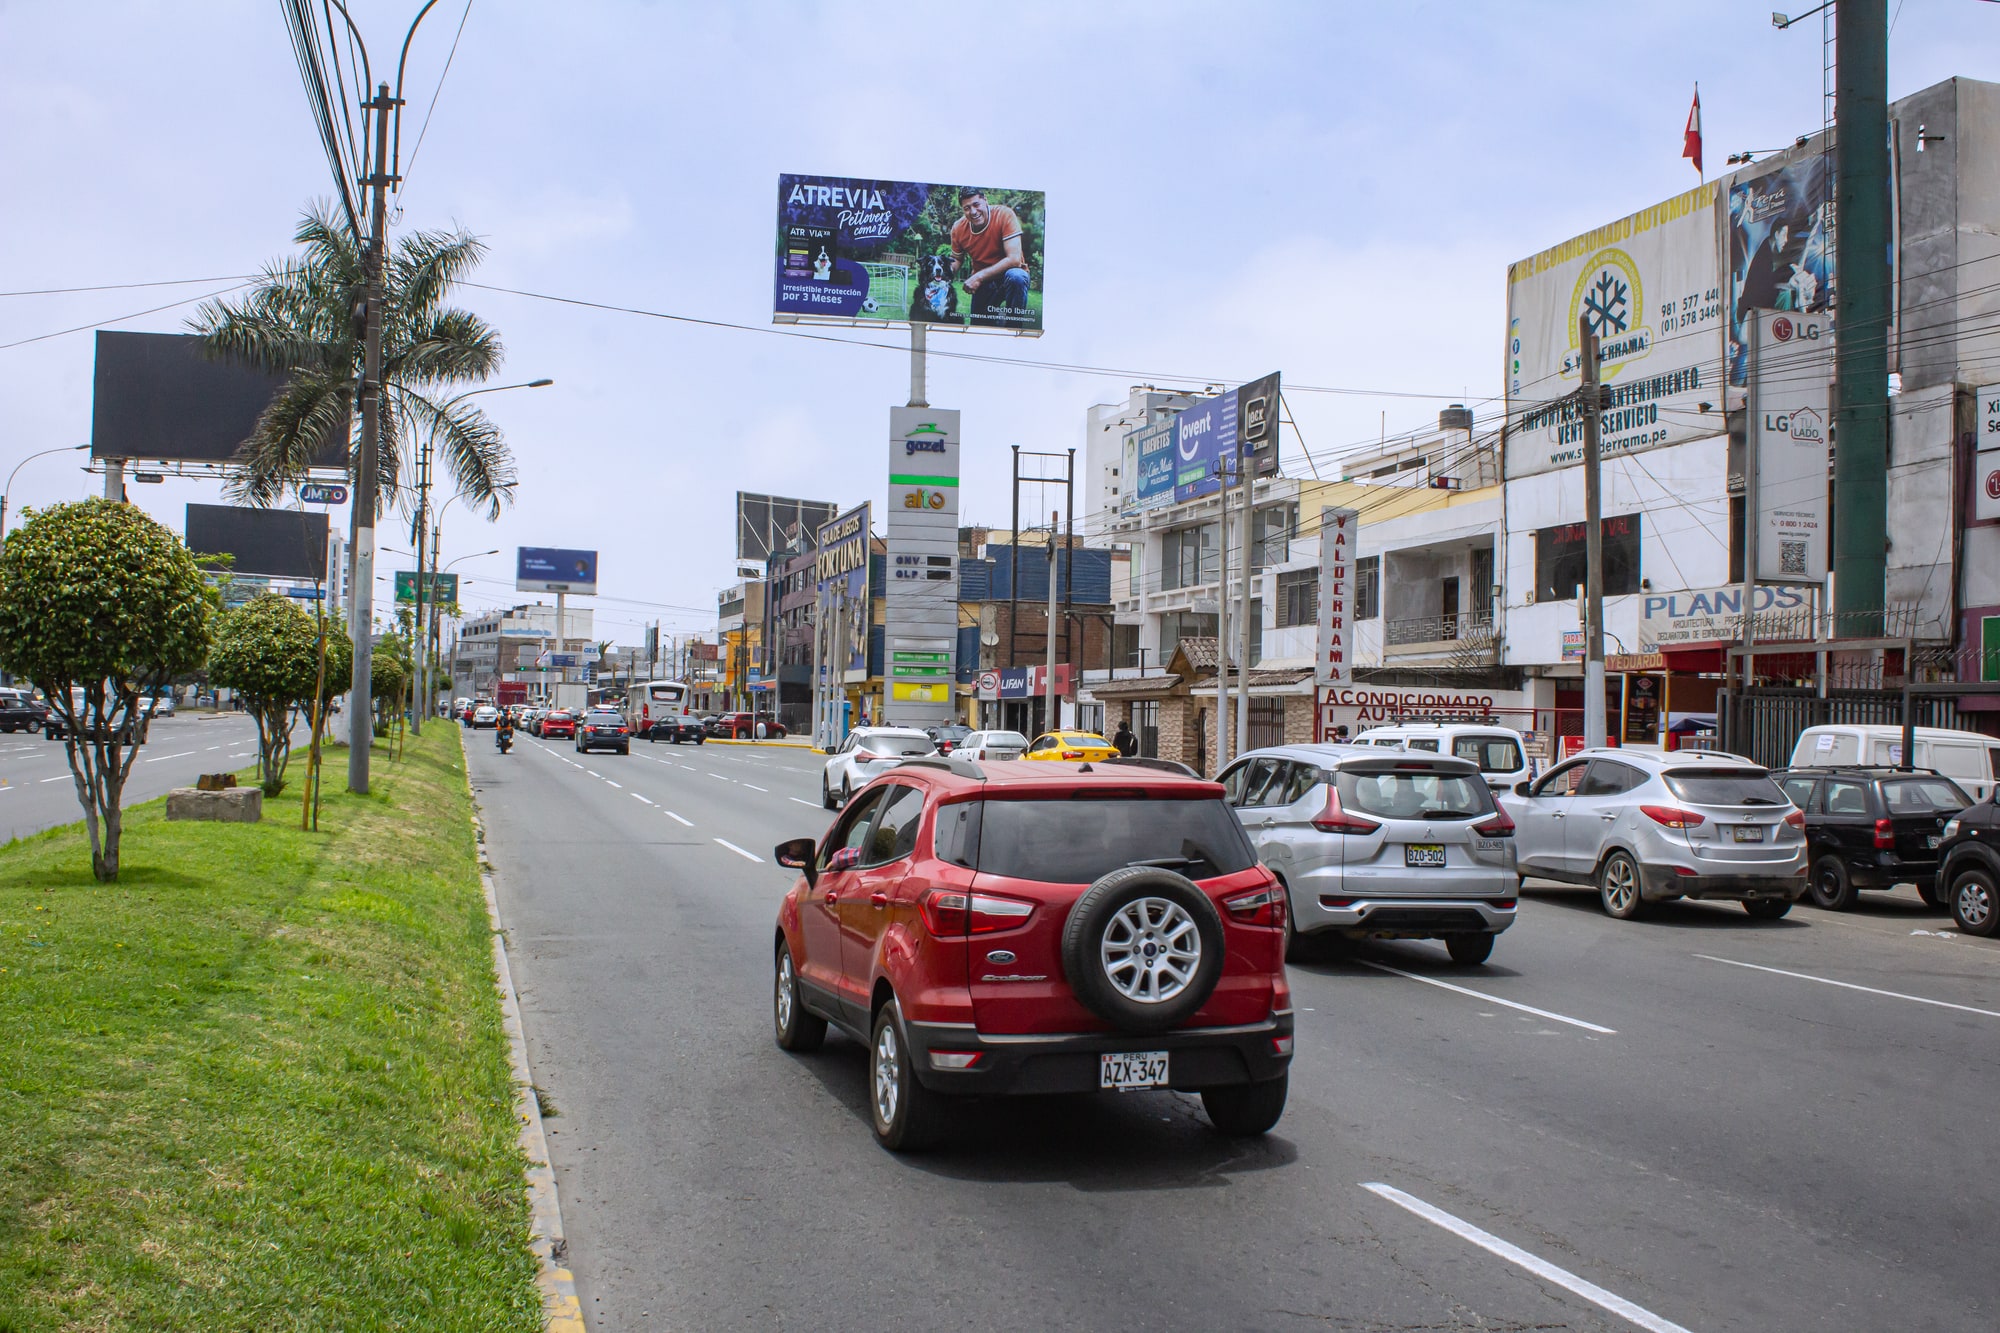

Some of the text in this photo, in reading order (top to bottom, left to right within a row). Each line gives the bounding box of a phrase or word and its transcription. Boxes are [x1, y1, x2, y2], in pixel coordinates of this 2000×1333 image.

[788, 184, 885, 210] ATREVIA
[837, 210, 892, 230] Petlovers
[854, 222, 893, 236] como tú
[1535, 213, 1631, 276] ACONDICIONADO
[783, 284, 862, 297] Irresistible Protección
[783, 292, 842, 304] por 3 Meses
[987, 305, 1035, 316] Checho Ibarra
[1661, 301, 1676, 318] 981
[1682, 293, 1699, 311] 577
[1661, 317, 1678, 337] (01)
[1680, 310, 1697, 327] 578
[1797, 322, 1819, 340] LG
[1558, 403, 1657, 446] VENT SERVICIO
[1766, 414, 1789, 432] LG
[1794, 428, 1819, 438] LADO
[906, 438, 946, 456] gazel
[1550, 429, 1667, 464] www.sderrama.pe
[904, 488, 946, 509] alto
[817, 537, 865, 582] FORTUNA
[1329, 514, 1347, 680] VALDERRAMA
[1644, 586, 1804, 620] PLANOS
[1673, 617, 1715, 629] ARQUITECTURA
[1693, 629, 1699, 639] DE
[1001, 678, 1025, 689] LIFAN
[1326, 689, 1493, 707] ACONDICIONADO
[1408, 849, 1445, 862] BZO-502
[1123, 1053, 1148, 1061] PERU
[1103, 1060, 1167, 1084] AZX-347
